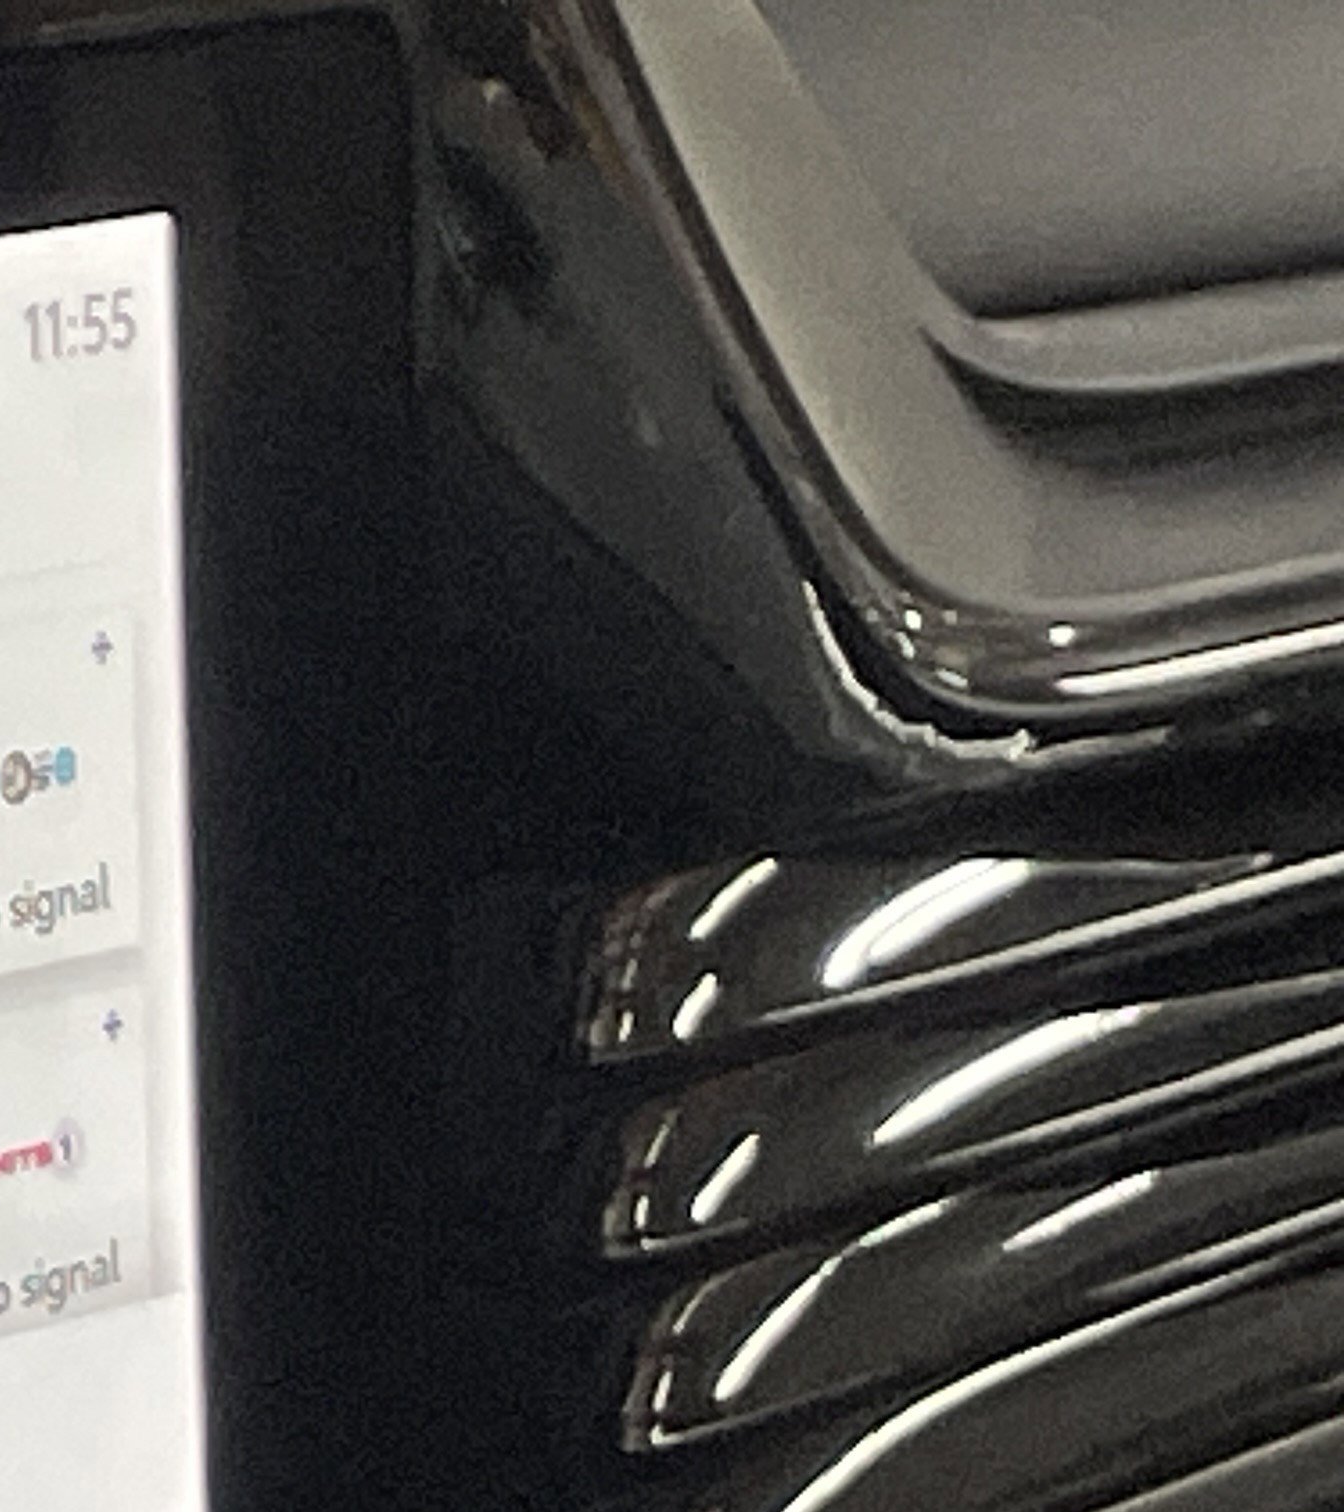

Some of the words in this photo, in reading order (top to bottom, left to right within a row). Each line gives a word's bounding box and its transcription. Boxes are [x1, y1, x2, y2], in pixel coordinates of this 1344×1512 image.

[24, 288, 137, 362] 11:55
[9, 861, 110, 932] signal
[18, 1239, 122, 1312] signal
